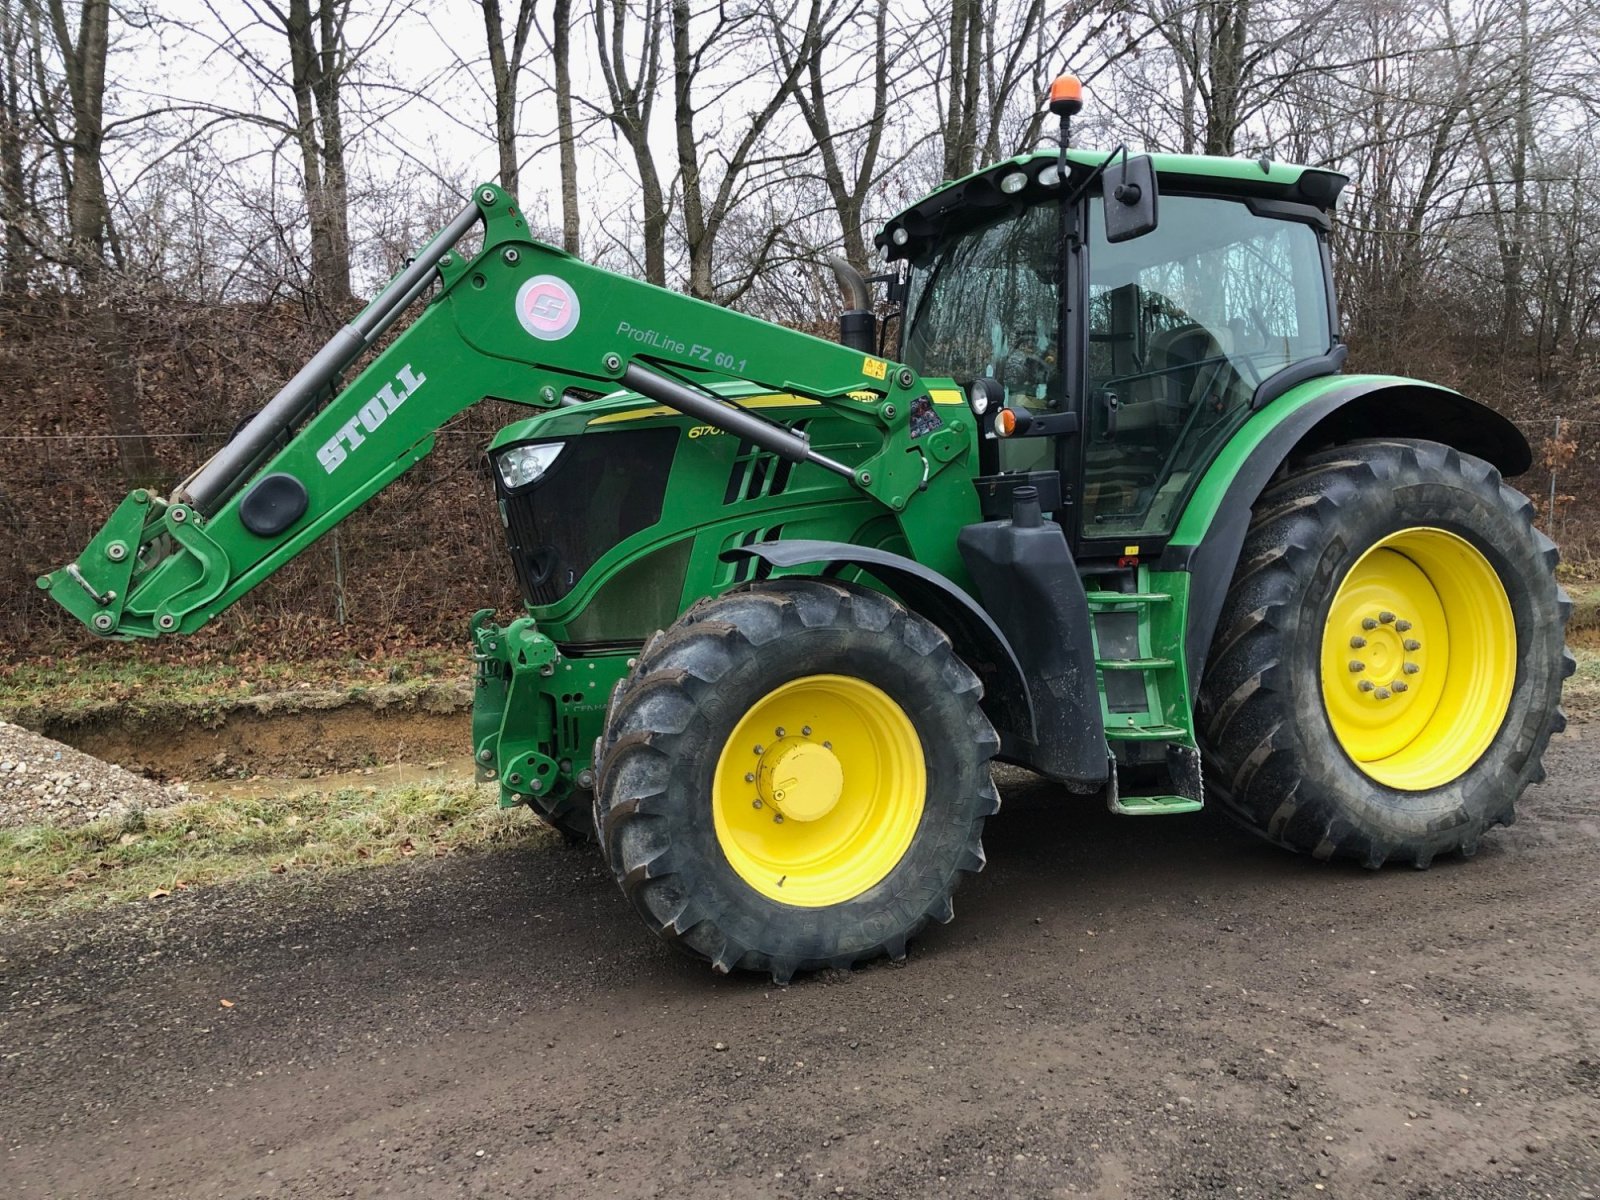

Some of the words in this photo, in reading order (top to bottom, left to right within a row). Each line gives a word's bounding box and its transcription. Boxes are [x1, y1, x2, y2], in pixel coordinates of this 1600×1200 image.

[616, 321, 685, 353] ProfiLine
[689, 343, 712, 362] FZ
[715, 351, 747, 372] 60.1
[316, 363, 427, 475] STOLL
[688, 425, 726, 439] 6170
